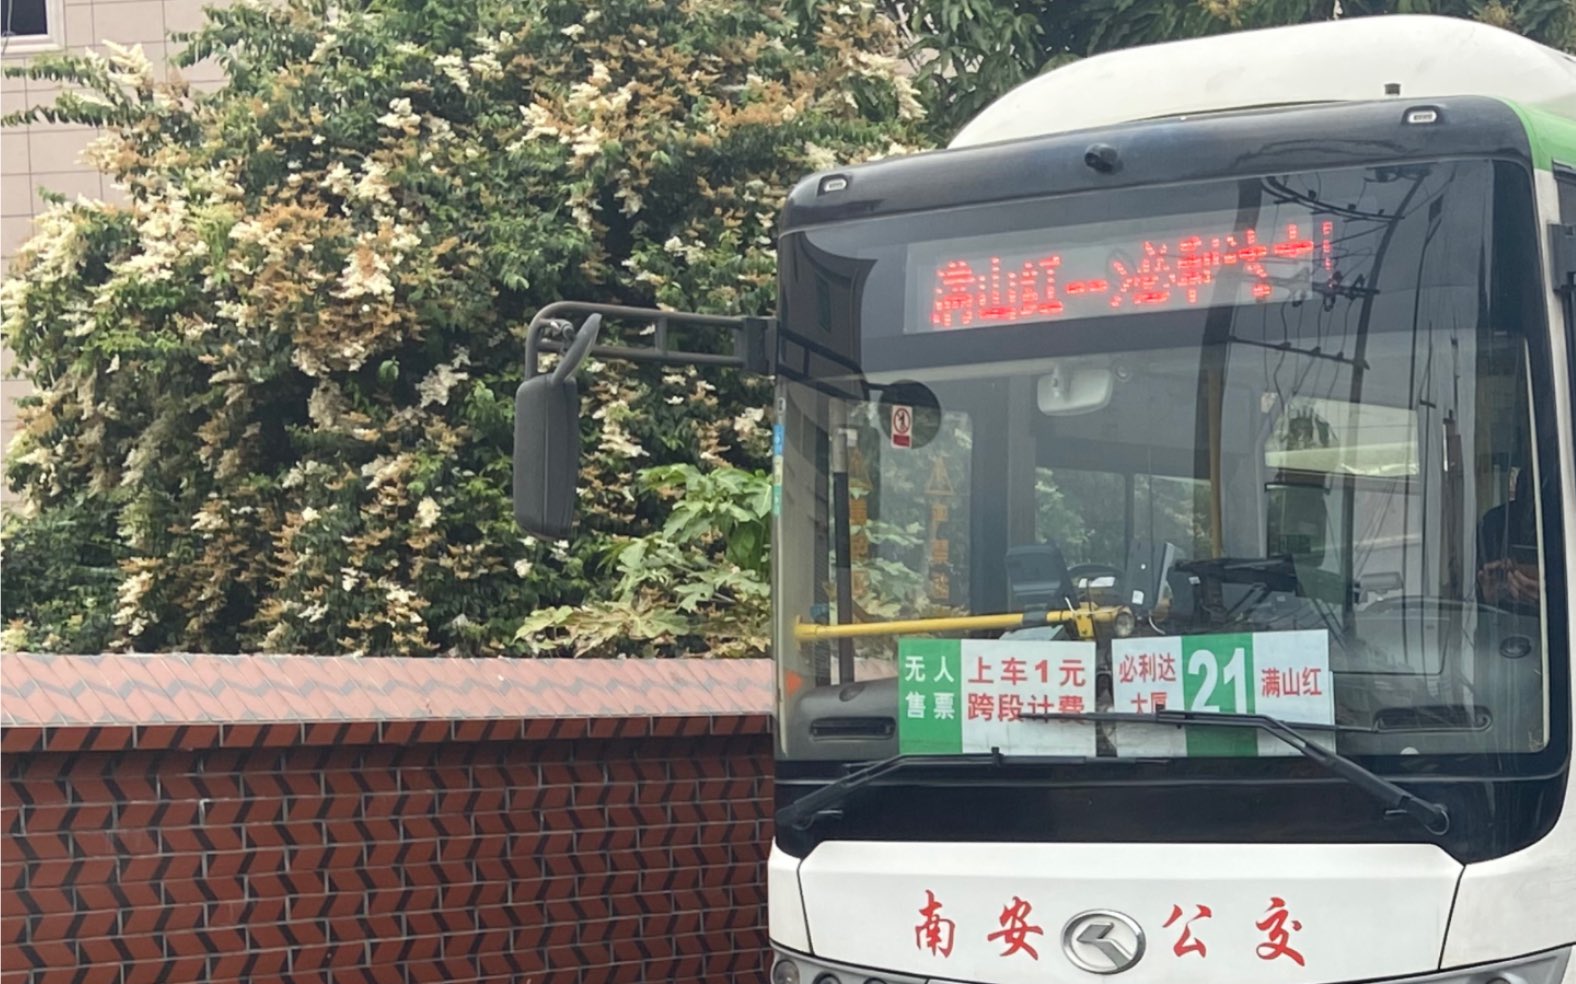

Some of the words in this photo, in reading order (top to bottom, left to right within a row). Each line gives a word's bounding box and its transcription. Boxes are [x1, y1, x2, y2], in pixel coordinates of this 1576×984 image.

[905, 655, 955, 683] 无人
[967, 656, 1086, 688] 上车1元
[1118, 652, 1177, 684] 必利达
[1187, 647, 1249, 715] 21
[1261, 667, 1322, 698] 满山红
[905, 691, 956, 720] 售票
[967, 693, 1086, 722] 跨段计费
